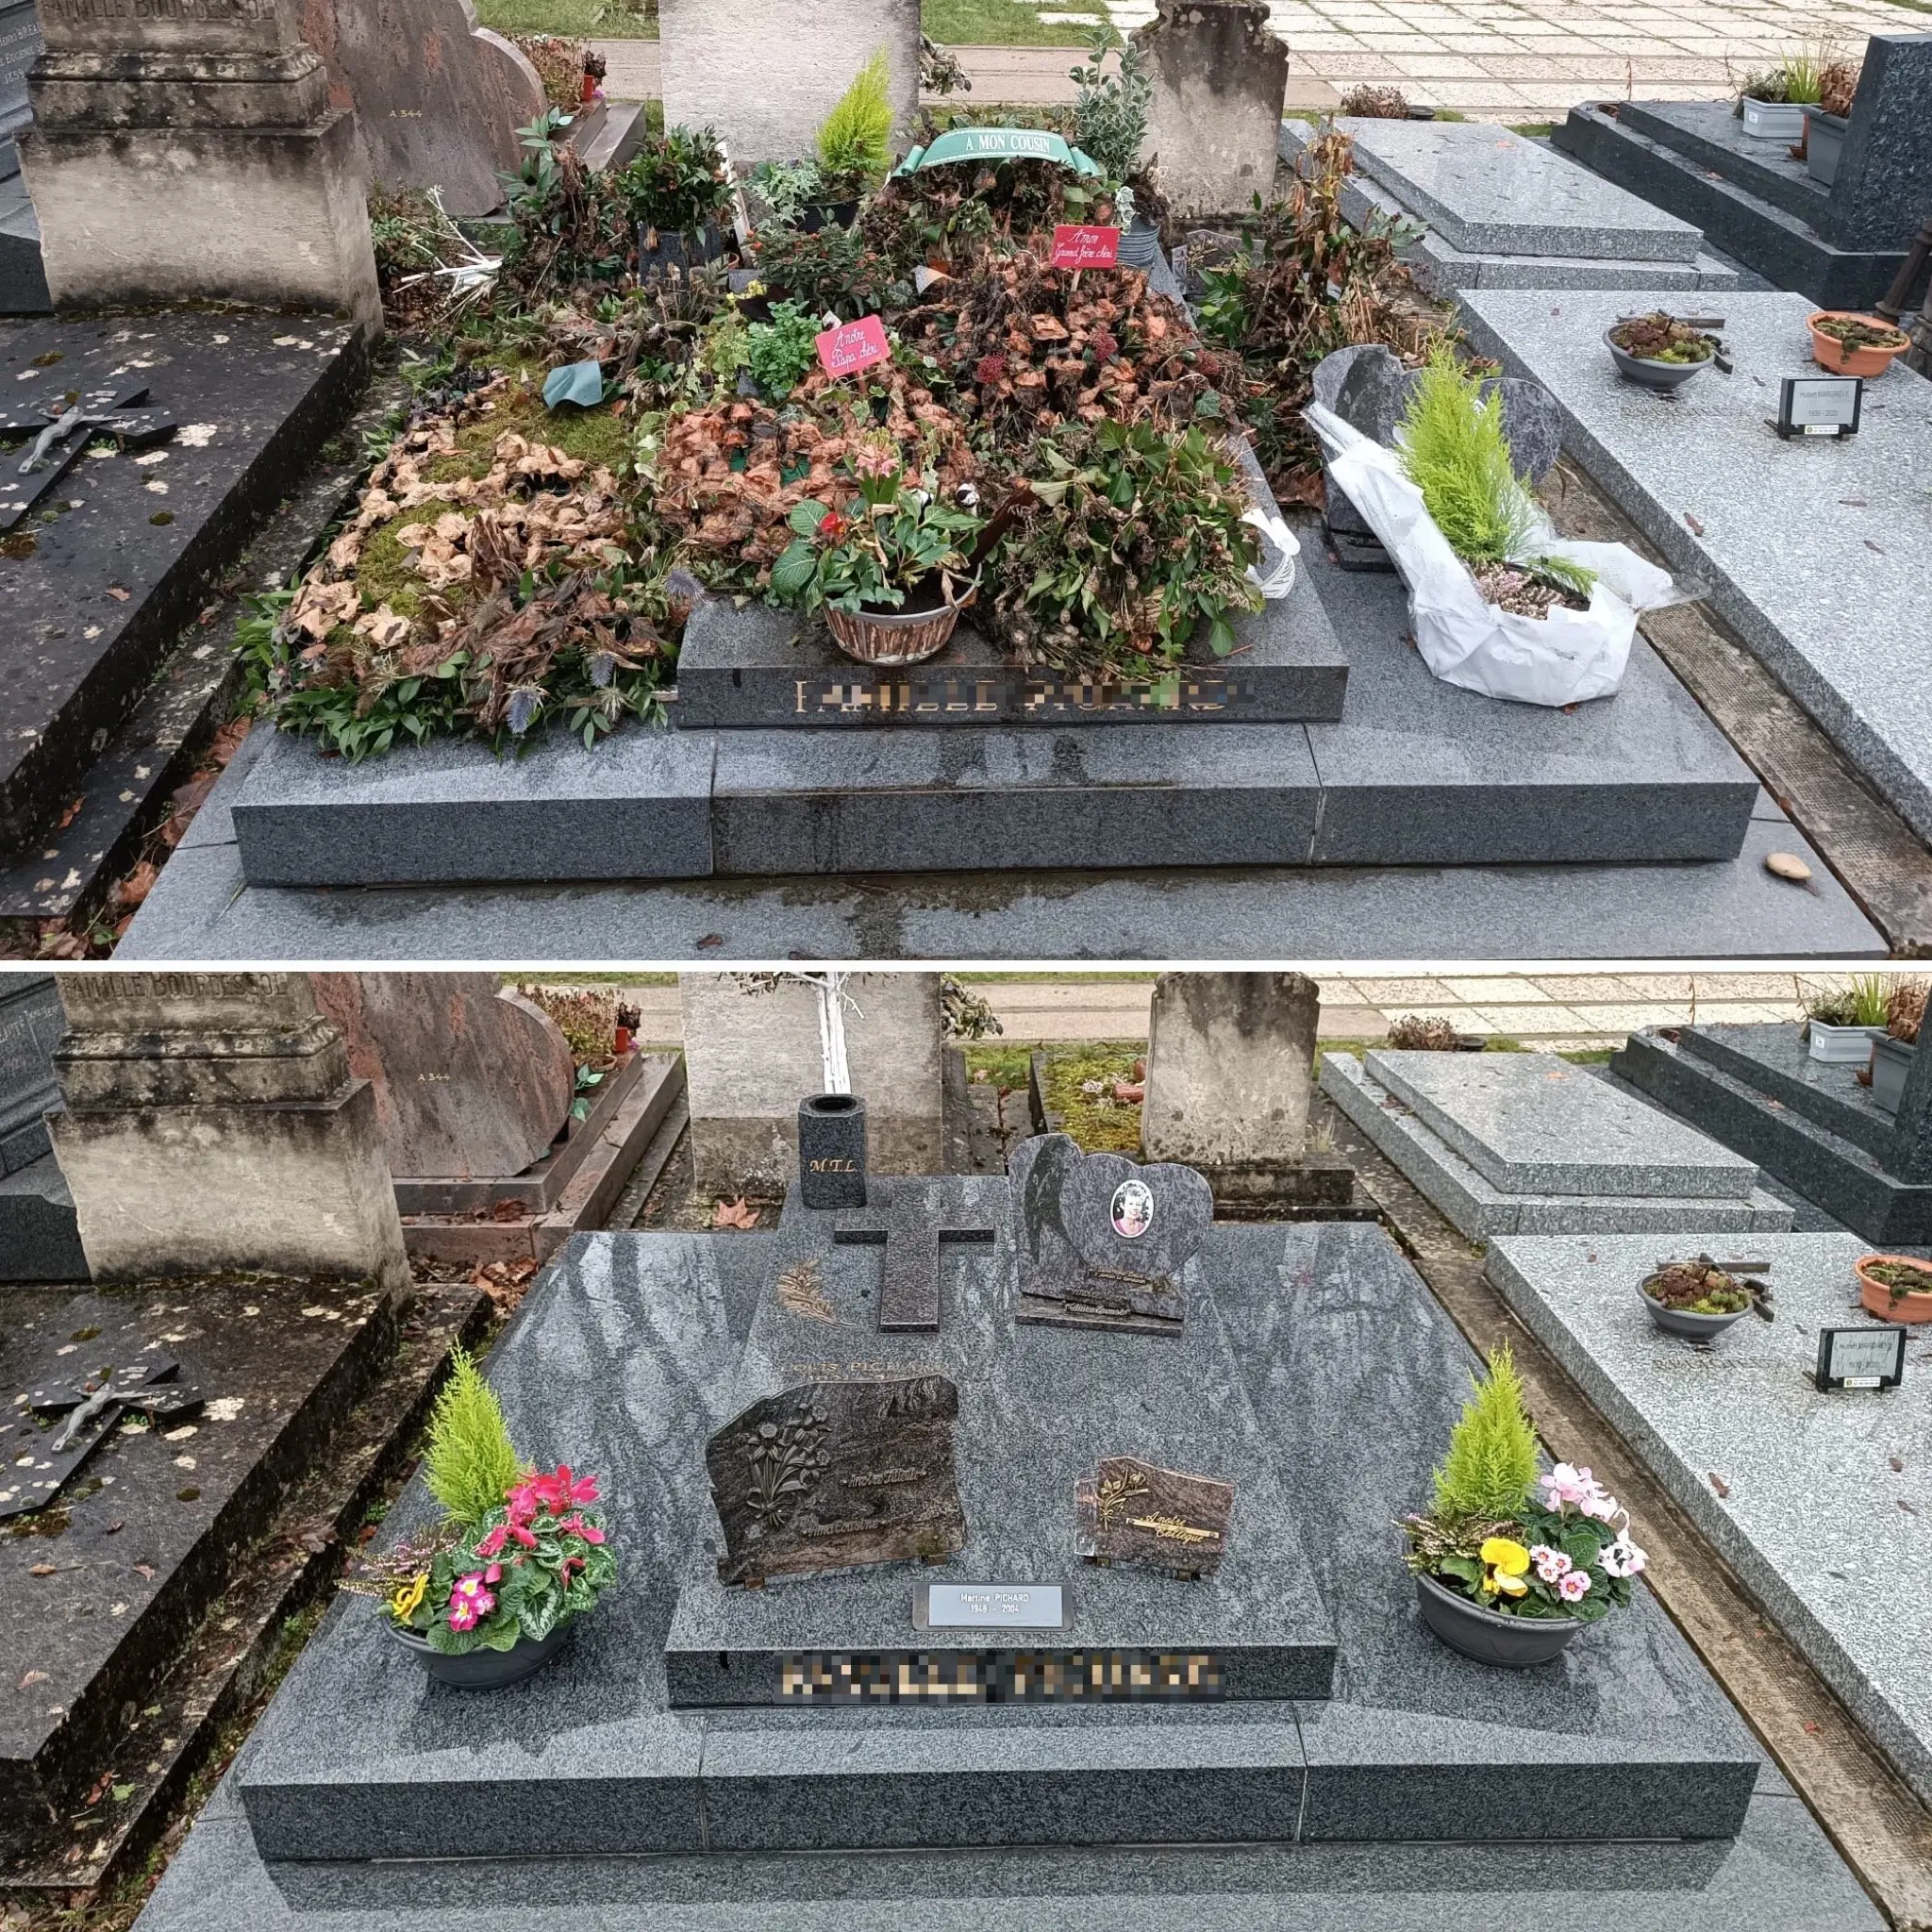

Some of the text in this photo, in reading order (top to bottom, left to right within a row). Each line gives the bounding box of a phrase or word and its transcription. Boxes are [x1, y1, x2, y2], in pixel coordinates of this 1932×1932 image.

[965, 135, 1050, 153] A MON COUSIN
[1081, 234, 1099, 243] mon
[831, 348, 857, 371] Papa
[61, 975, 147, 998] FAMILLE
[960, 1593, 1029, 1602] Martine PICHARD
[1001, 1604, 1020, 1613] 2004
